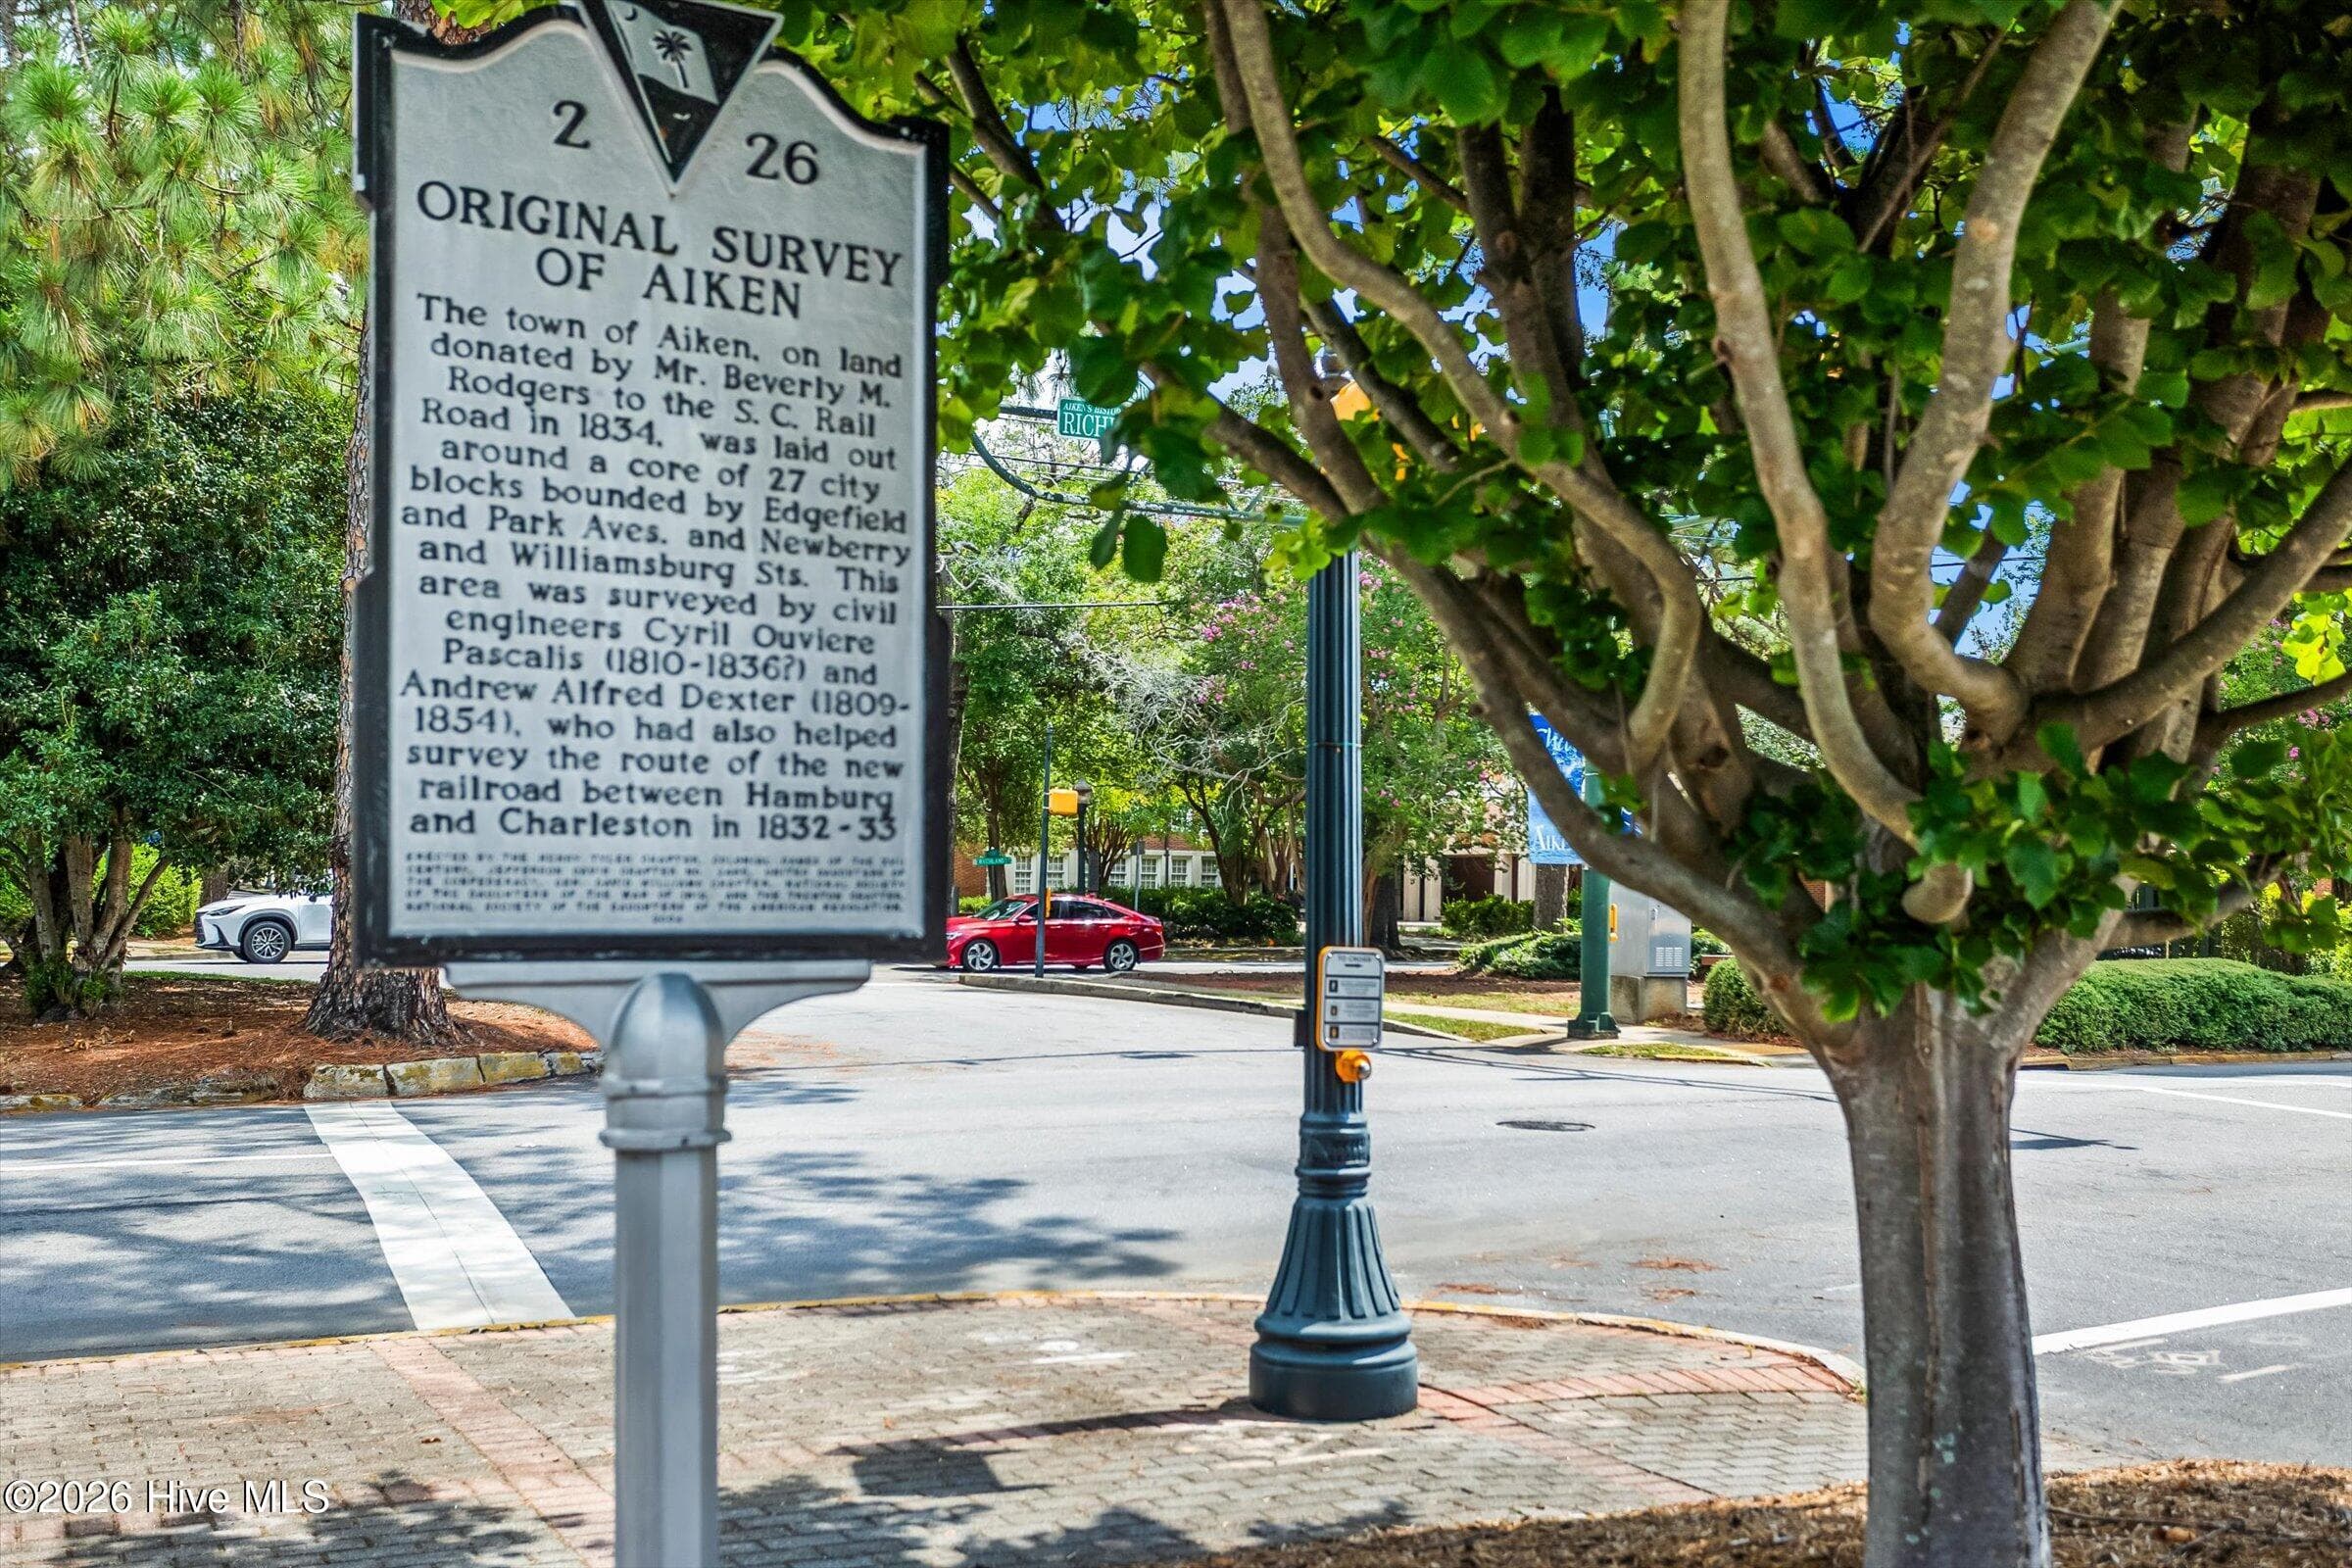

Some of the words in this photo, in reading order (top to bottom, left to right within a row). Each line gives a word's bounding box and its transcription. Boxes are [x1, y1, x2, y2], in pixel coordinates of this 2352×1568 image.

[553, 100, 591, 149] 2
[745, 132, 820, 185] 26
[416, 179, 680, 259] ORIGINAL
[710, 224, 905, 289] SURVEY
[535, 246, 605, 291] OF
[642, 262, 802, 319] AIKEN
[416, 291, 489, 328] The
[505, 306, 588, 341] town
[604, 318, 640, 347] of
[781, 345, 822, 369] on
[839, 345, 905, 380] land
[429, 330, 574, 372] donated
[590, 346, 634, 383] by
[653, 353, 708, 387] Mr.
[722, 363, 847, 407] Beverly
[858, 378, 892, 410] M.
[448, 365, 591, 407] Rodgers
[612, 385, 647, 413] to
[661, 390, 716, 420] the
[733, 397, 760, 426] S.
[768, 401, 800, 431] C.
[814, 405, 877, 439] Rail
[420, 396, 512, 432] Road
[529, 408, 560, 436] in
[698, 431, 759, 457] was
[772, 433, 830, 466] laid
[847, 446, 898, 471] out
[409, 463, 524, 501] blocks
[541, 474, 687, 516] bounded
[704, 490, 745, 525] by
[762, 495, 908, 536] Edgefield
[440, 438, 569, 472] around
[588, 454, 609, 475] a
[626, 456, 702, 484] core
[716, 461, 752, 489] of
[767, 466, 808, 495] 27
[819, 471, 881, 506] city
[400, 502, 469, 531] and
[486, 503, 566, 539] Park
[581, 513, 668, 546] Aves.
[687, 525, 748, 554] and
[760, 526, 912, 569] Newberry
[417, 538, 489, 566] and
[509, 539, 736, 591] Williamsburg
[754, 560, 810, 588] Sts.
[834, 564, 901, 596] This
[417, 574, 503, 601] area
[526, 581, 588, 606] was
[606, 586, 759, 617] surveyed
[777, 592, 817, 625] by
[831, 596, 898, 626] civil
[444, 608, 623, 643] engineers
[643, 615, 731, 649] Cyril
[751, 622, 876, 657] Ouviere
[442, 636, 584, 672] Pascalis
[605, 646, 808, 682] (1810-1836?)
[822, 662, 879, 687] and
[399, 668, 539, 703] Andrew
[550, 676, 665, 710] Alfred
[679, 681, 797, 714] Dexter
[809, 688, 910, 718] (1809-
[545, 711, 616, 741] who
[633, 713, 695, 744] had
[710, 716, 778, 745] also
[792, 719, 899, 753] helped
[406, 744, 530, 772] survey
[546, 743, 602, 772] the
[619, 750, 711, 776] route
[726, 747, 762, 776] of
[775, 751, 829, 778] the
[843, 758, 905, 780] new
[409, 808, 478, 836] and
[497, 806, 693, 839] Charleston
[711, 812, 741, 840] in
[418, 773, 563, 804] railroad
[581, 777, 724, 808] between
[746, 781, 895, 818] Hamburg
